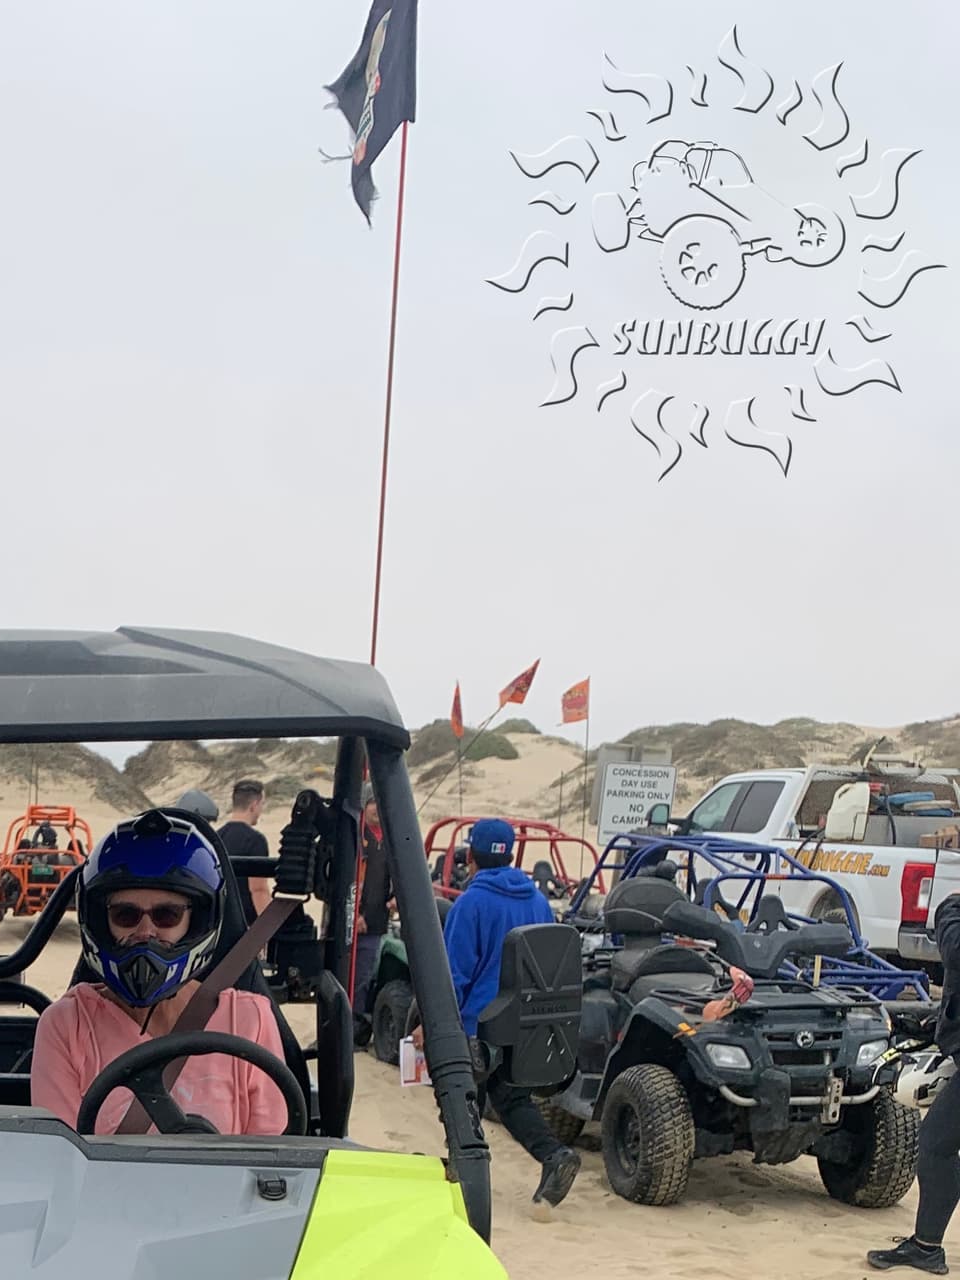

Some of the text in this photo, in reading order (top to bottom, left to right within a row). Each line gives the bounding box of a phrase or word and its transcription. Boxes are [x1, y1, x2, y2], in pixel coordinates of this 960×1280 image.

[612, 767, 670, 779] CONCESSION
[621, 779, 659, 789] DAY USE
[606, 789, 671, 801] PARKING ONLY
[629, 803, 645, 813] NO
[611, 815, 645, 825] CAMPI
